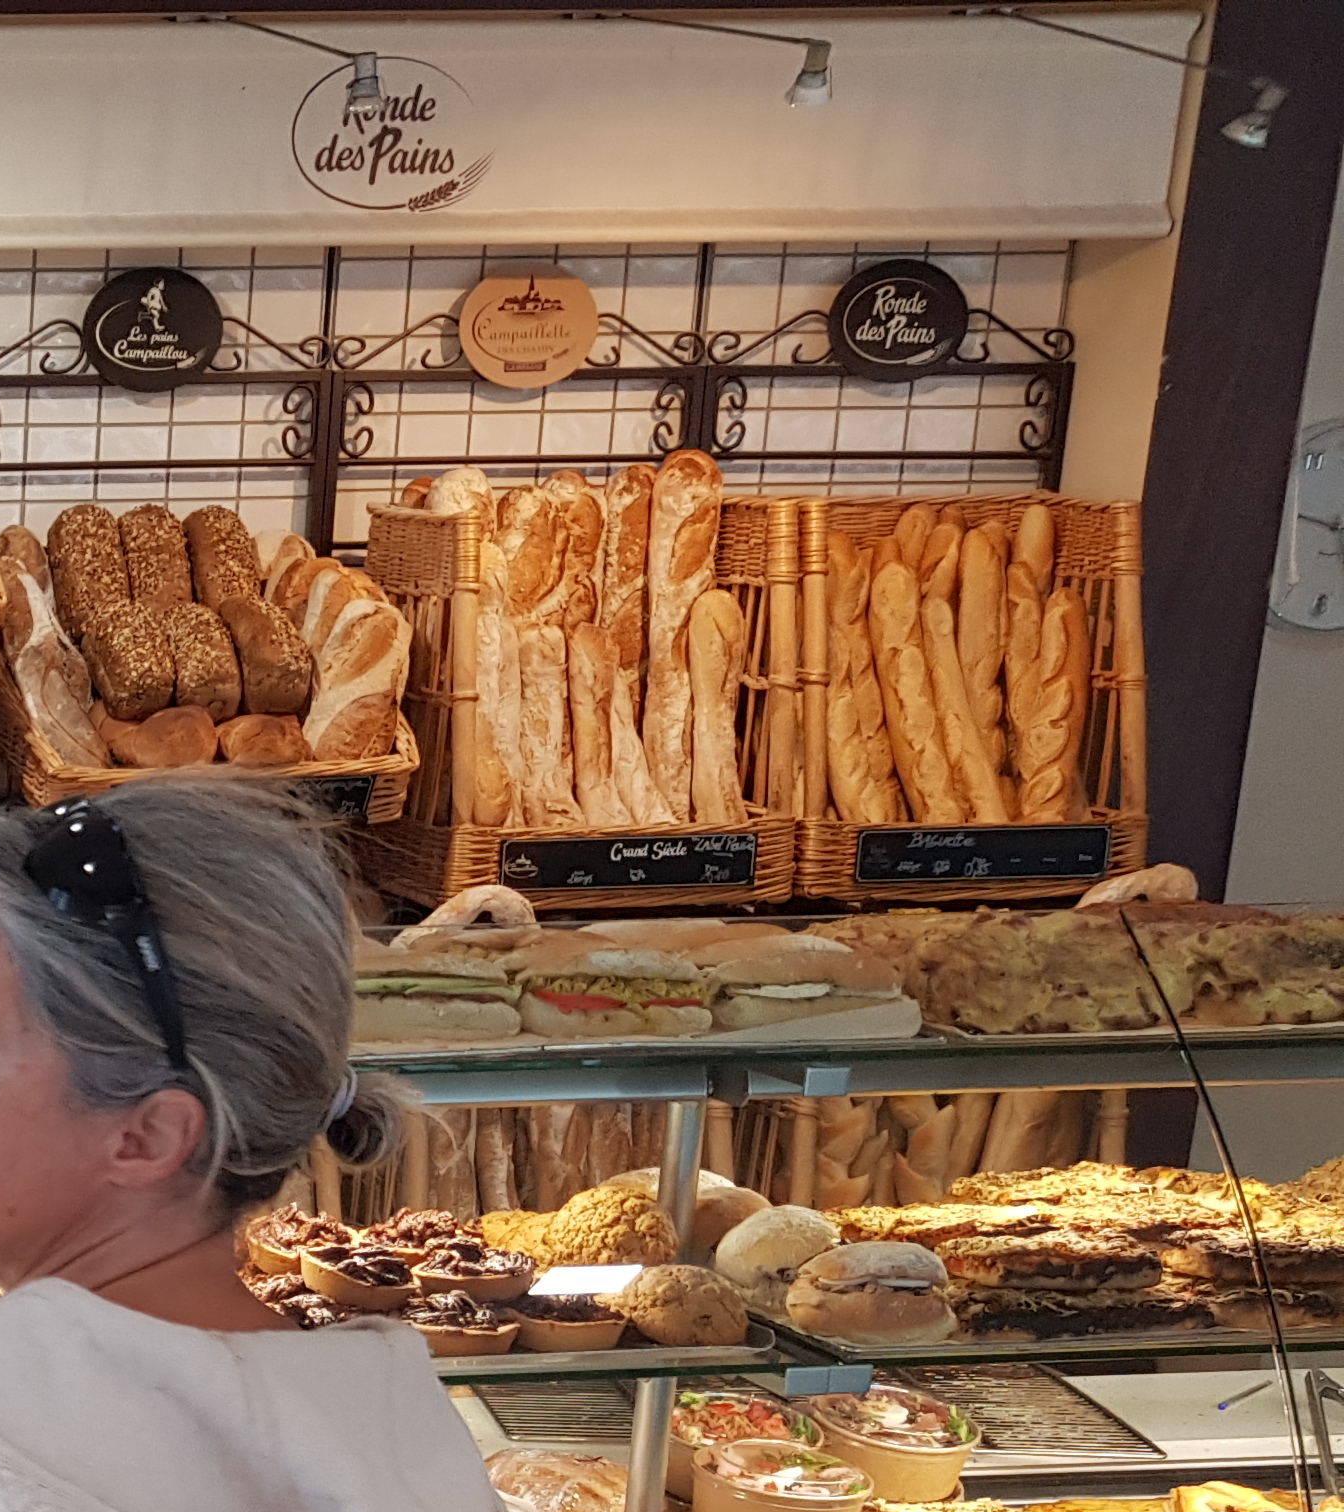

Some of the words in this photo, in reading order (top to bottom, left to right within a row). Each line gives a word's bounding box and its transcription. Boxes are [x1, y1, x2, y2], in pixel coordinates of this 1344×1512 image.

[315, 134, 365, 172] des
[368, 125, 454, 185] Pains
[872, 285, 927, 320] Ronde
[127, 326, 147, 341] Les
[151, 331, 179, 345] pains
[856, 318, 885, 341] des
[885, 314, 936, 349] Pains
[113, 339, 188, 363] Campaillou
[611, 842, 649, 861] Grand
